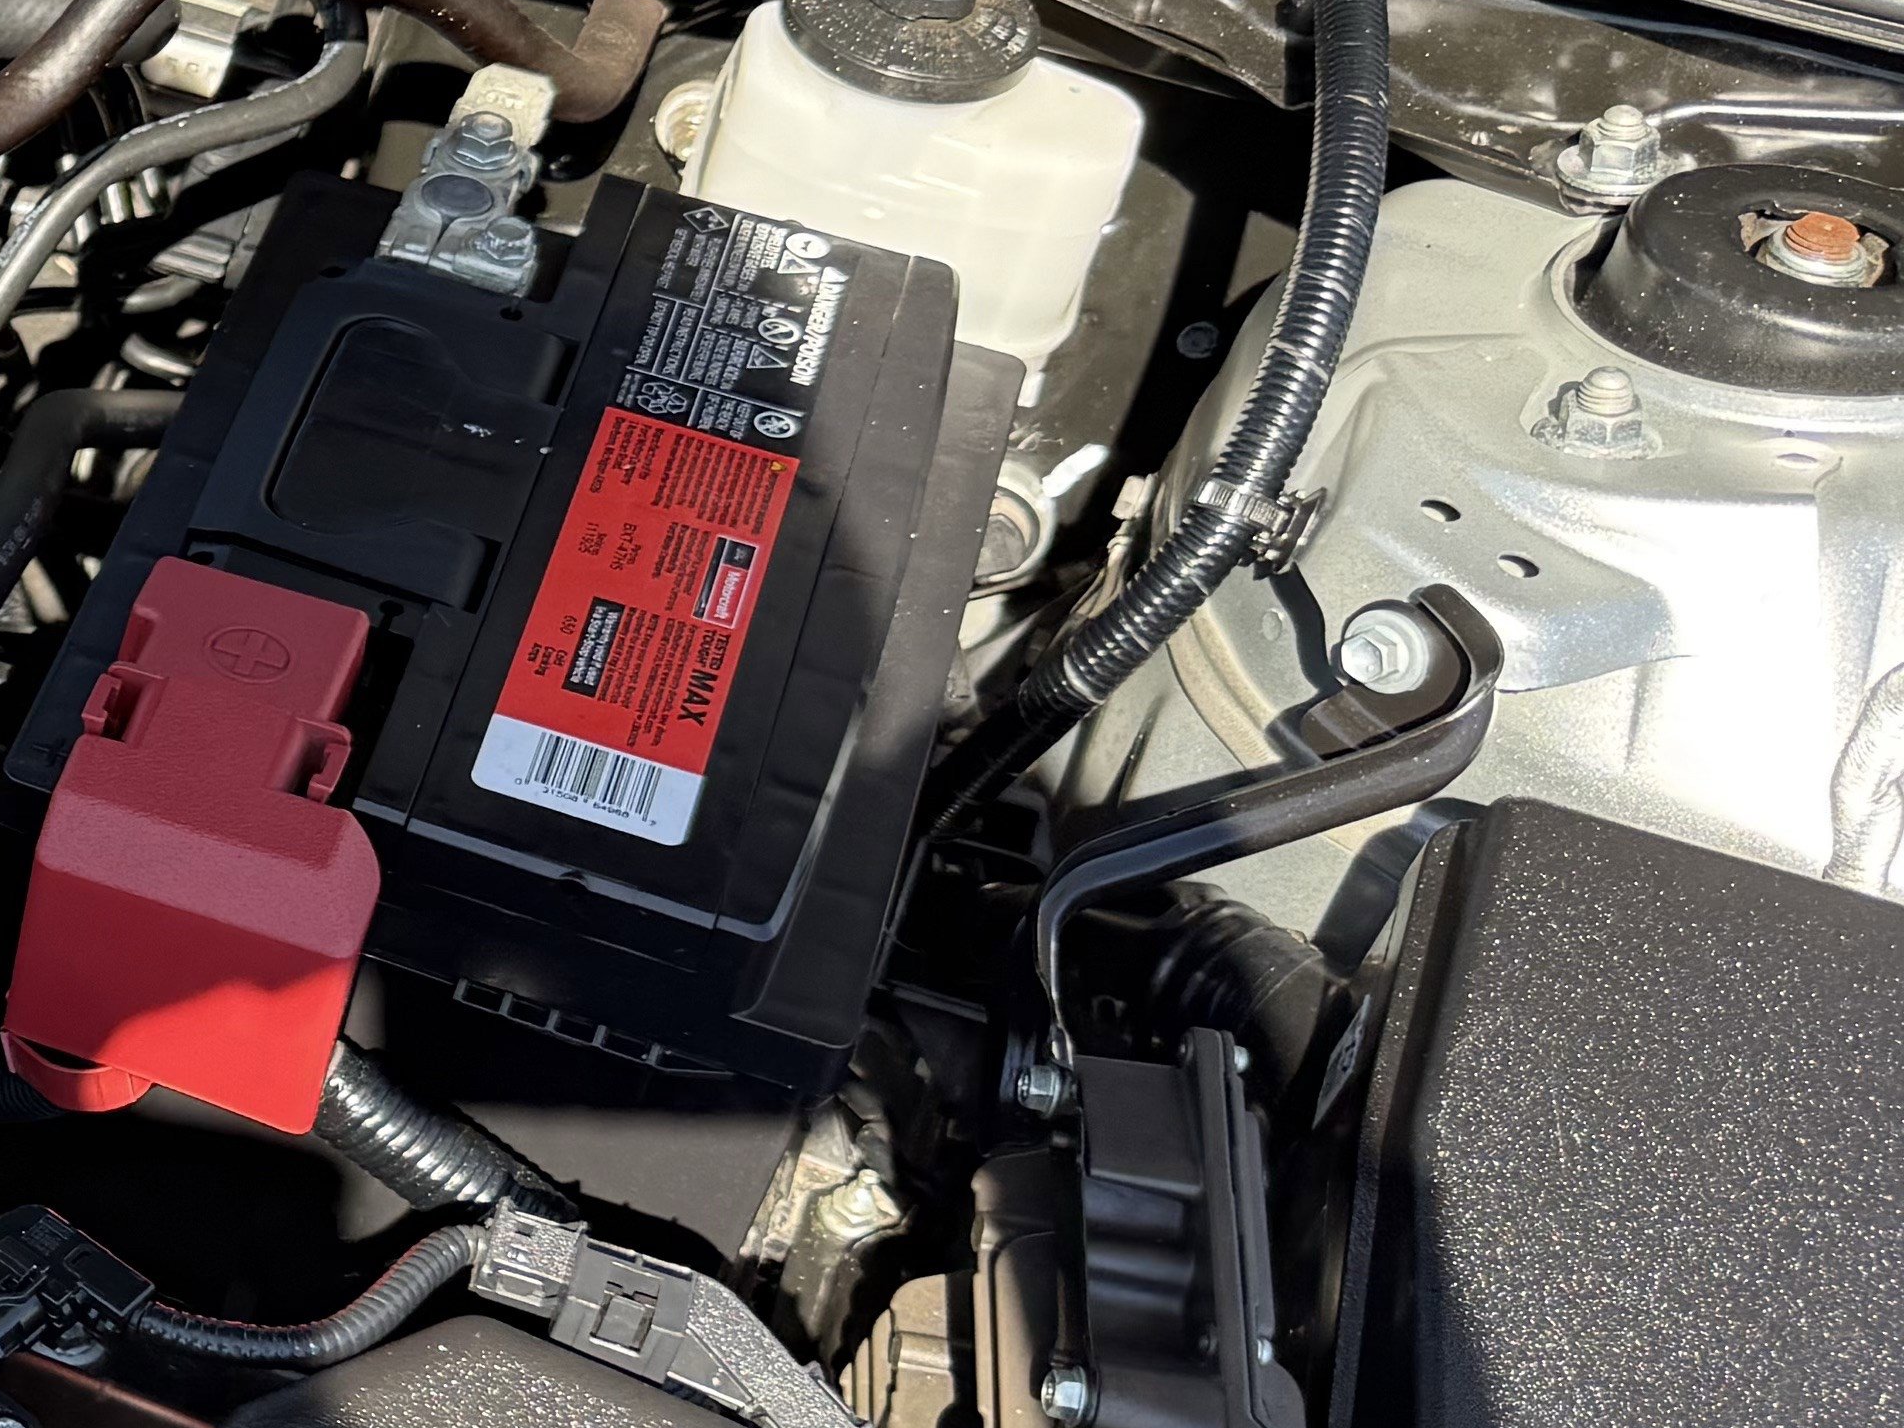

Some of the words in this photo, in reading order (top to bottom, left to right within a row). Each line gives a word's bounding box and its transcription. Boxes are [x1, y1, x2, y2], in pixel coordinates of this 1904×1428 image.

[788, 279, 841, 387] DANGER/POISON
[713, 569, 741, 621] Motorcraft
[708, 631, 731, 672] TESTED
[676, 667, 718, 728] MAX
